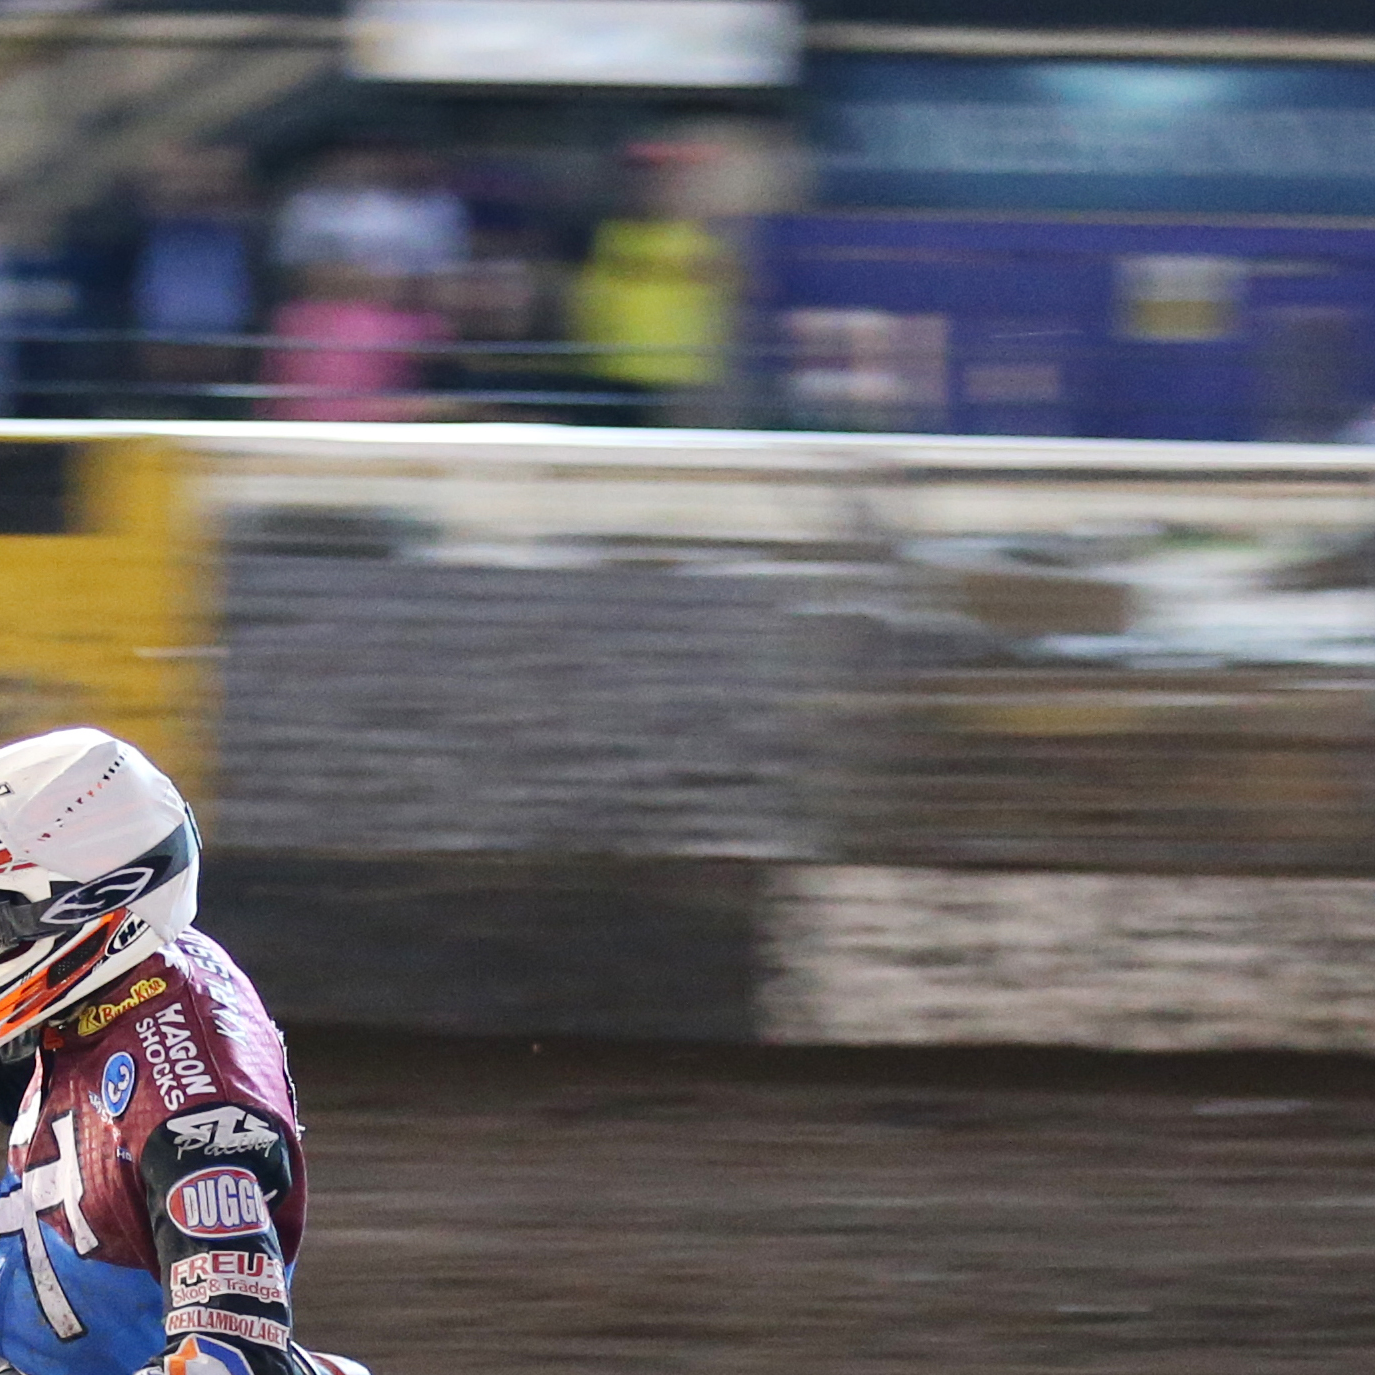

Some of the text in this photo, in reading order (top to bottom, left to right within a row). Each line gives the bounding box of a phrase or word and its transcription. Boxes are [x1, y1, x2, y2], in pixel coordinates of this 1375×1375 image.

[135, 1017, 185, 1112] SHOCKS
[155, 1002, 218, 1096] HAGON
[174, 1284, 207, 1305] Skog
[209, 1278, 222, 1294] &
[168, 1308, 287, 1348] REKLAMBOLAGET
